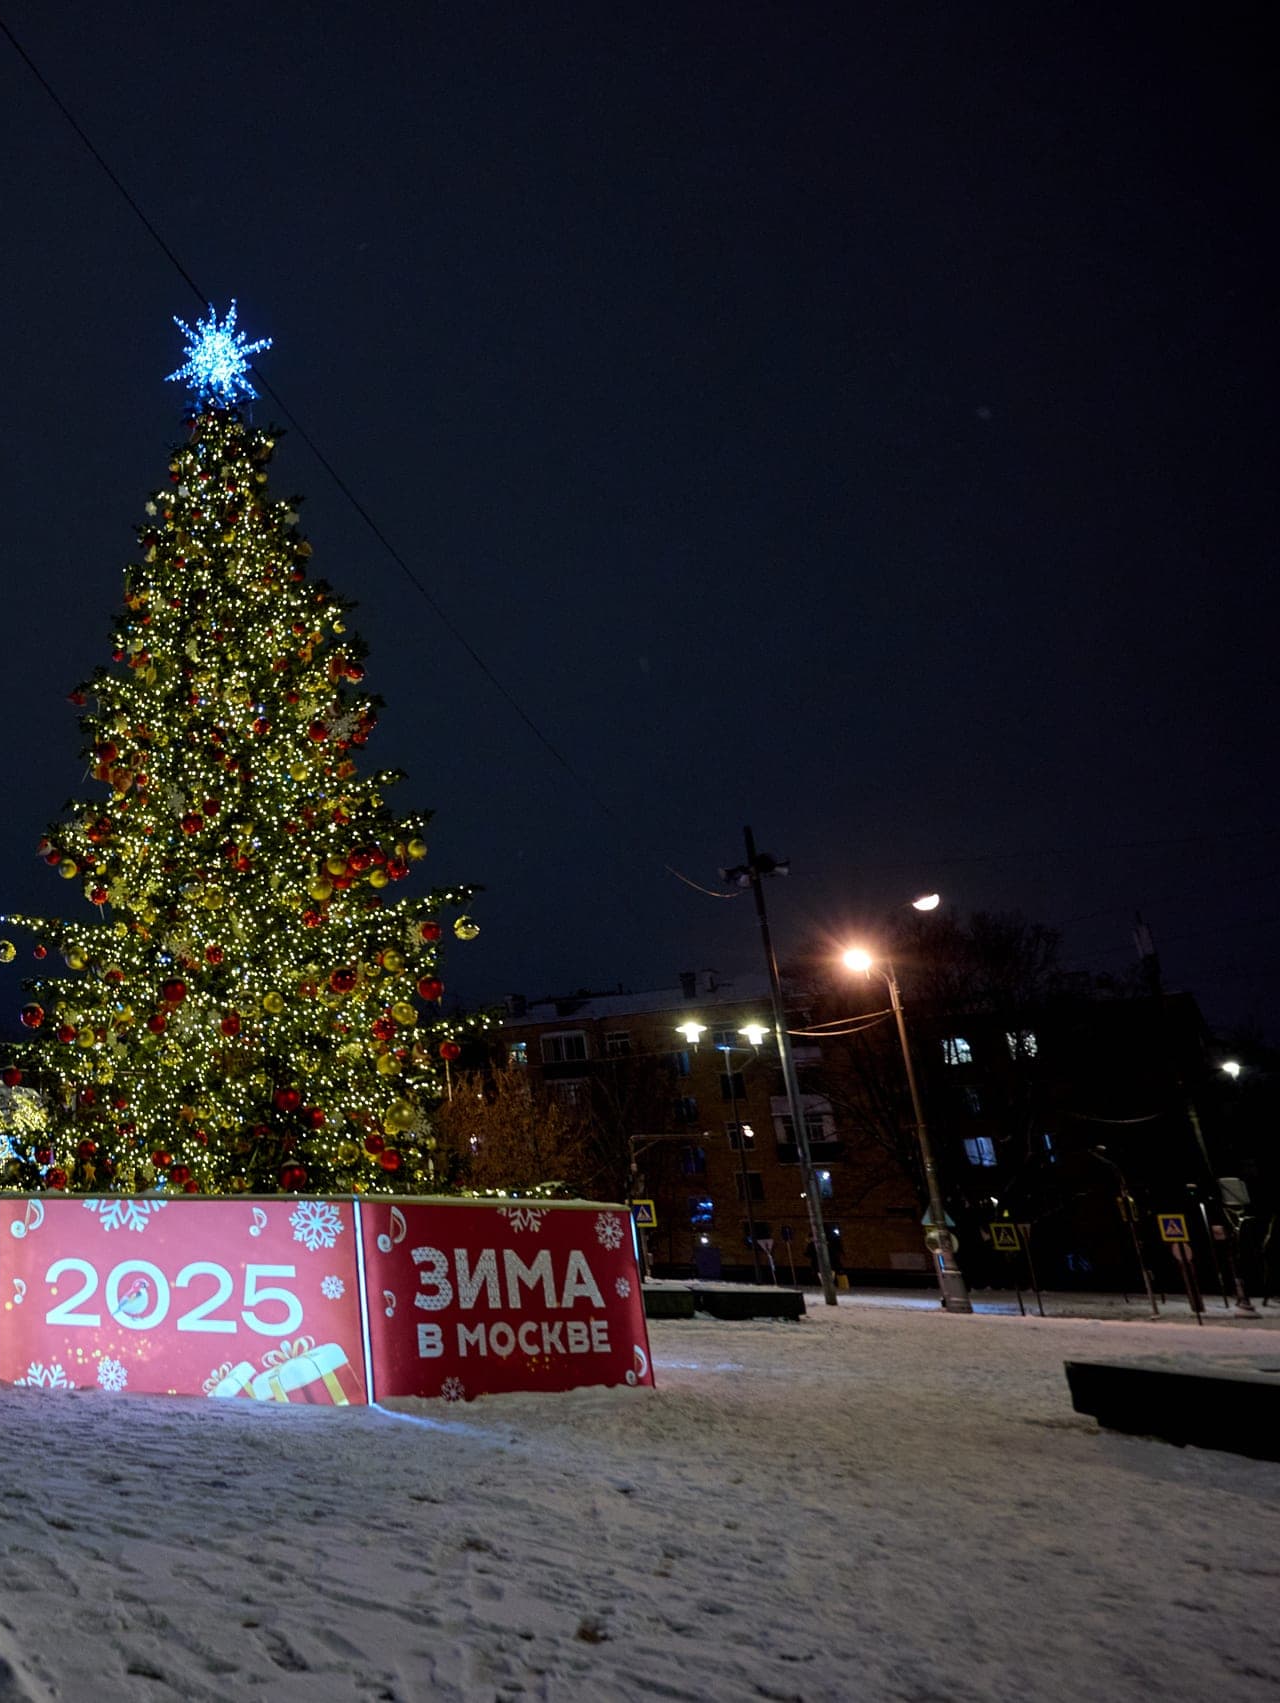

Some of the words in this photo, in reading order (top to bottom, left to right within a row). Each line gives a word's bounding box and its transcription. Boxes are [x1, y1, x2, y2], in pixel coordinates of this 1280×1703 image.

[45, 1257, 304, 1337] 2025
[410, 1246, 606, 1311] ЗИМА
[417, 1322, 445, 1358] В
[456, 1320, 612, 1357] МОСКВЕ
